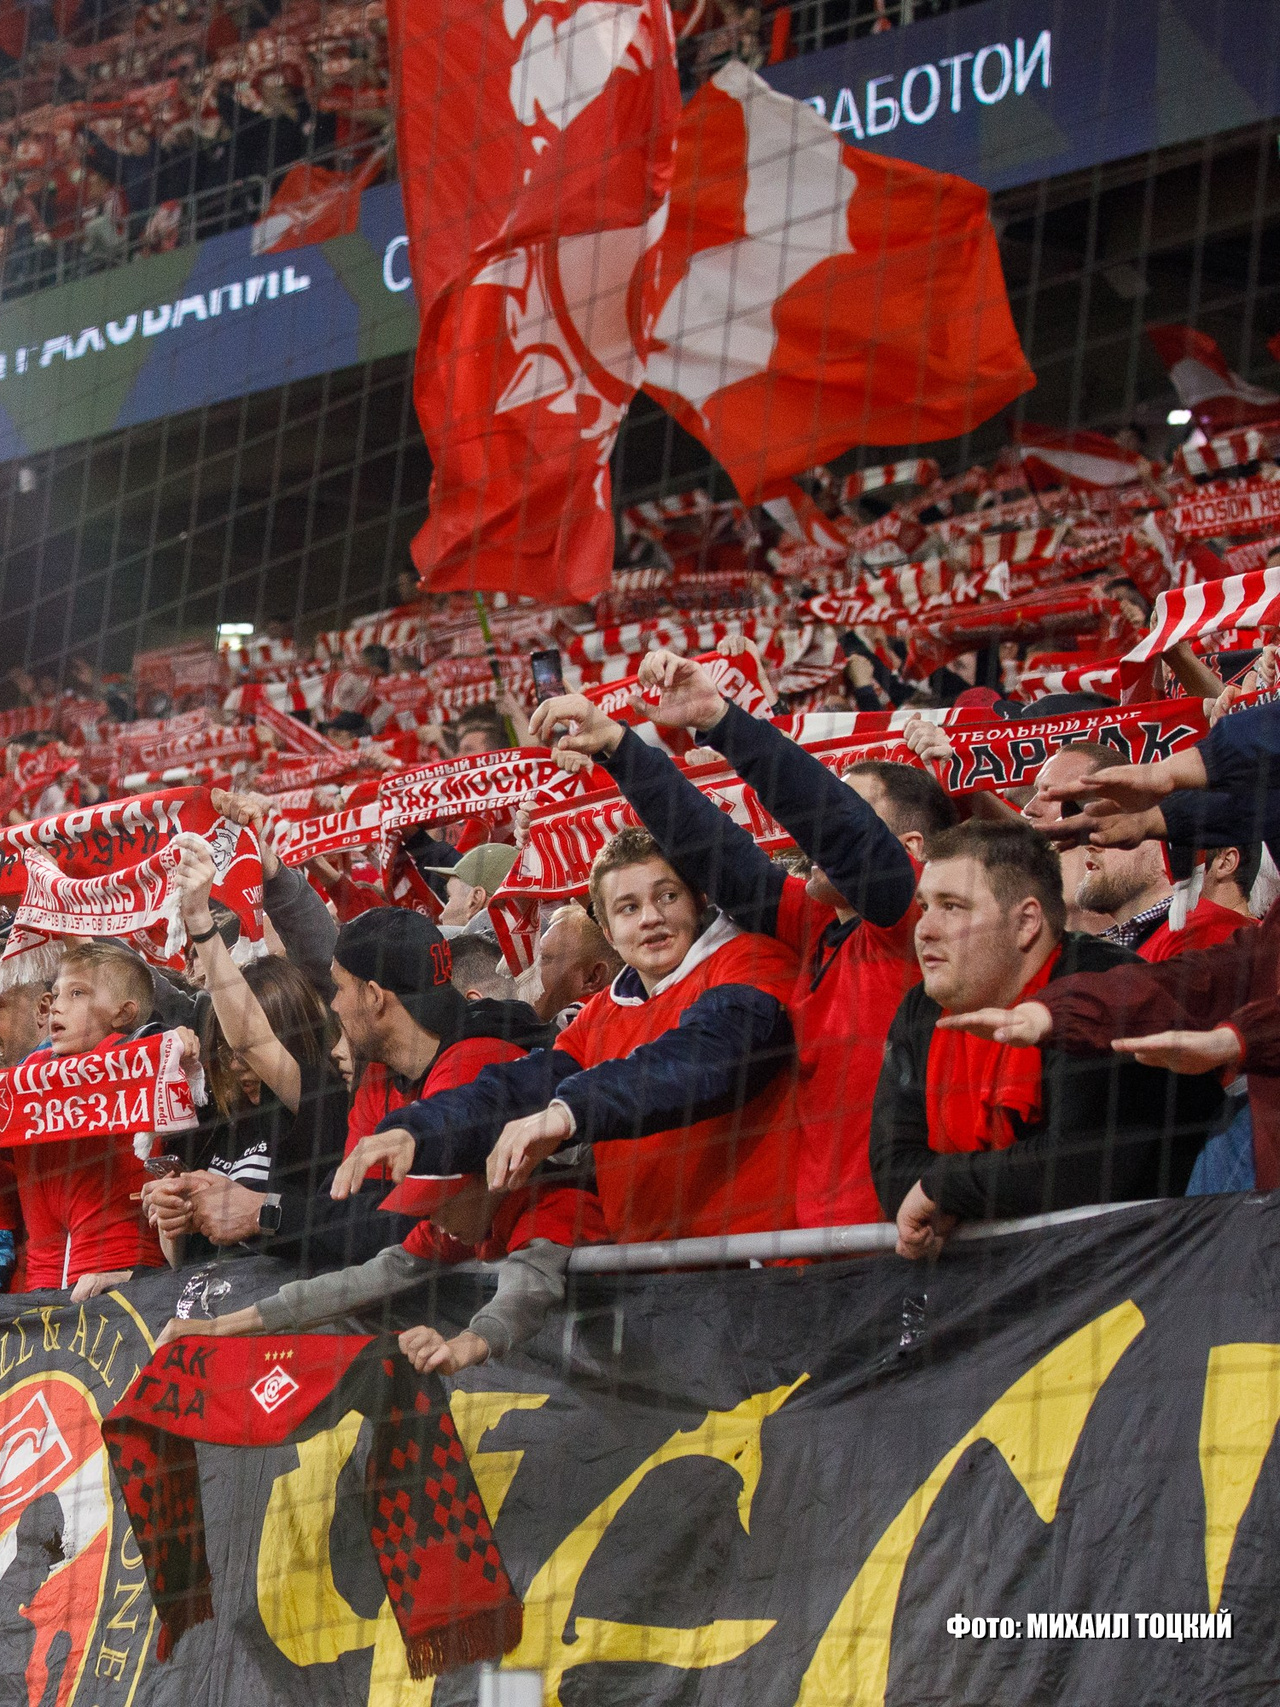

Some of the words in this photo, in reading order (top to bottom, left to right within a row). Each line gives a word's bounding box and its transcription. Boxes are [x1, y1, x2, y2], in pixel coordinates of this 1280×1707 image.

[476, 750, 521, 767] КЛУБ
[382, 810, 433, 829] МЕСТЕ!
[285, 845, 318, 865] LET'
[12, 1045, 155, 1095] ЦРВЕНА
[23, 1086, 152, 1140] ЗВЕЗДА
[41, 1306, 62, 1351] &
[68, 1303, 123, 1388] ALL
